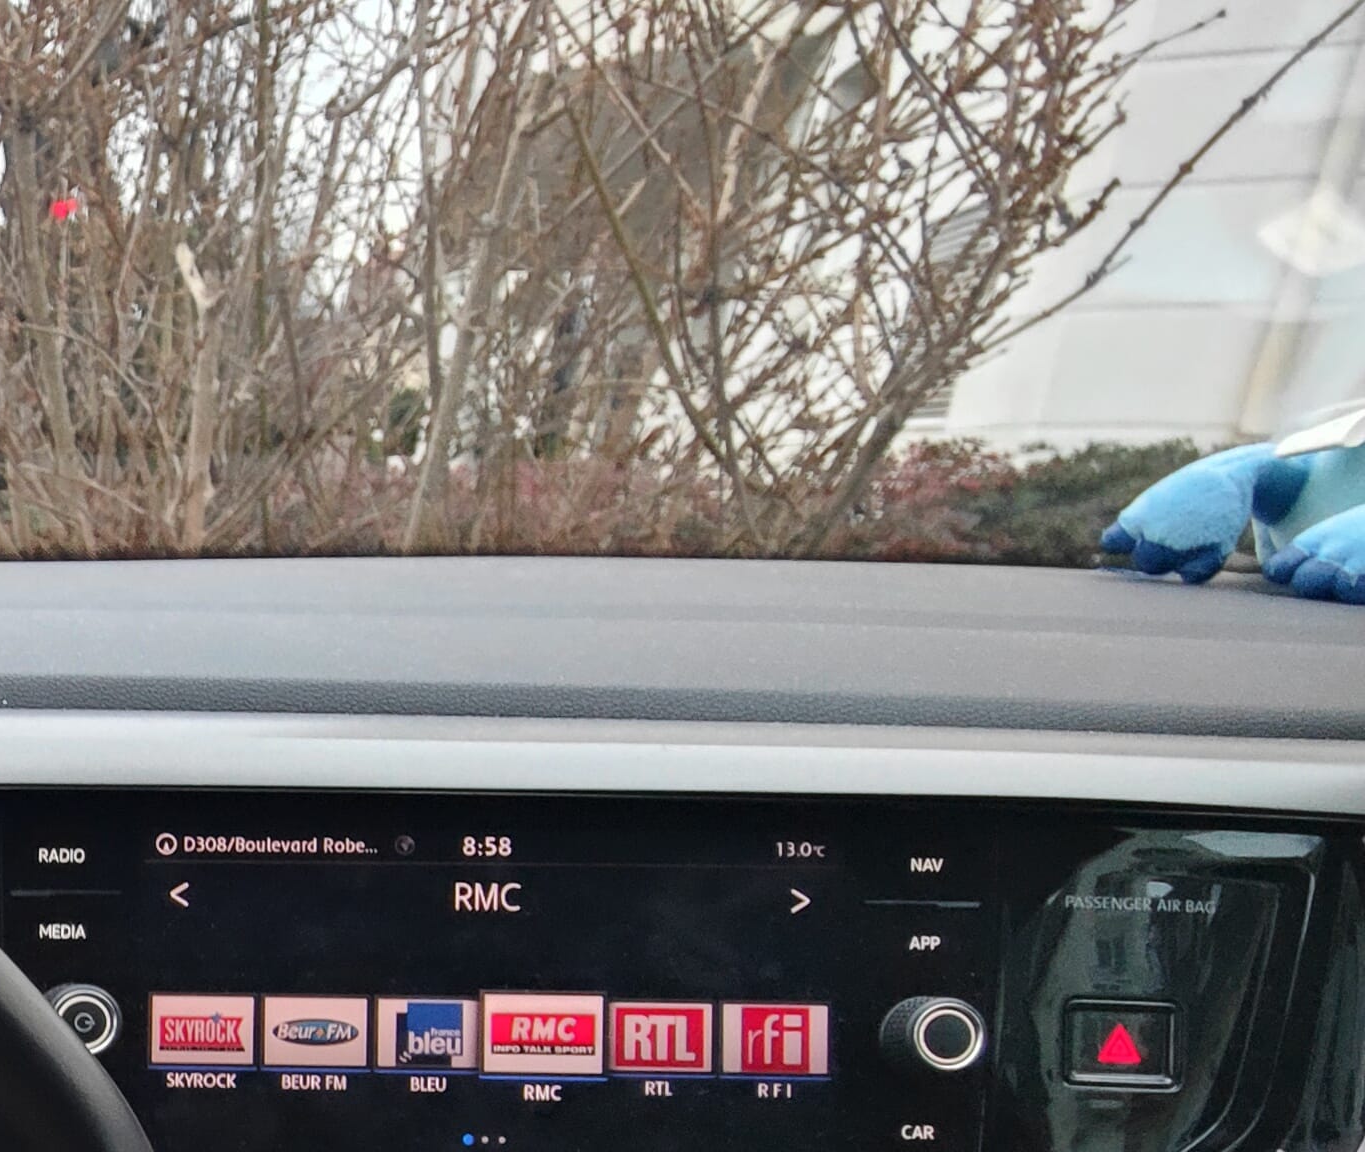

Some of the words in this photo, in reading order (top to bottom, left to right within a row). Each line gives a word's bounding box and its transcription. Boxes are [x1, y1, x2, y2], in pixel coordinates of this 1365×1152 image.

[184, 836, 318, 853] D308/Boulevard
[462, 837, 512, 857] 8:58
[38, 847, 86, 864] RADIO
[910, 857, 944, 873] NAV
[454, 882, 522, 912] RMC
[1064, 894, 1153, 911] PASSENGER
[1156, 897, 1182, 913] AIR
[1185, 899, 1218, 914] BAG
[38, 923, 87, 940] MEDIA
[908, 935, 941, 951] APP
[164, 1018, 238, 1043] SKYROCK
[277, 1024, 315, 1041] Beur
[327, 1024, 353, 1041] FM
[511, 1016, 577, 1041] RMC
[407, 1032, 462, 1056] bleu
[623, 1014, 697, 1063] RTL
[746, 1013, 803, 1066] rfi
[492, 1045, 521, 1055] INFO
[523, 1045, 553, 1055] TALK
[554, 1045, 595, 1055] SPORT
[166, 1071, 237, 1089] SKYROCK
[281, 1073, 321, 1091] BEUR
[325, 1074, 348, 1091] FM
[410, 1076, 447, 1093] BLEU
[644, 1080, 674, 1097] RTL
[523, 1083, 562, 1102] RMC
[900, 1124, 935, 1140] CAR
